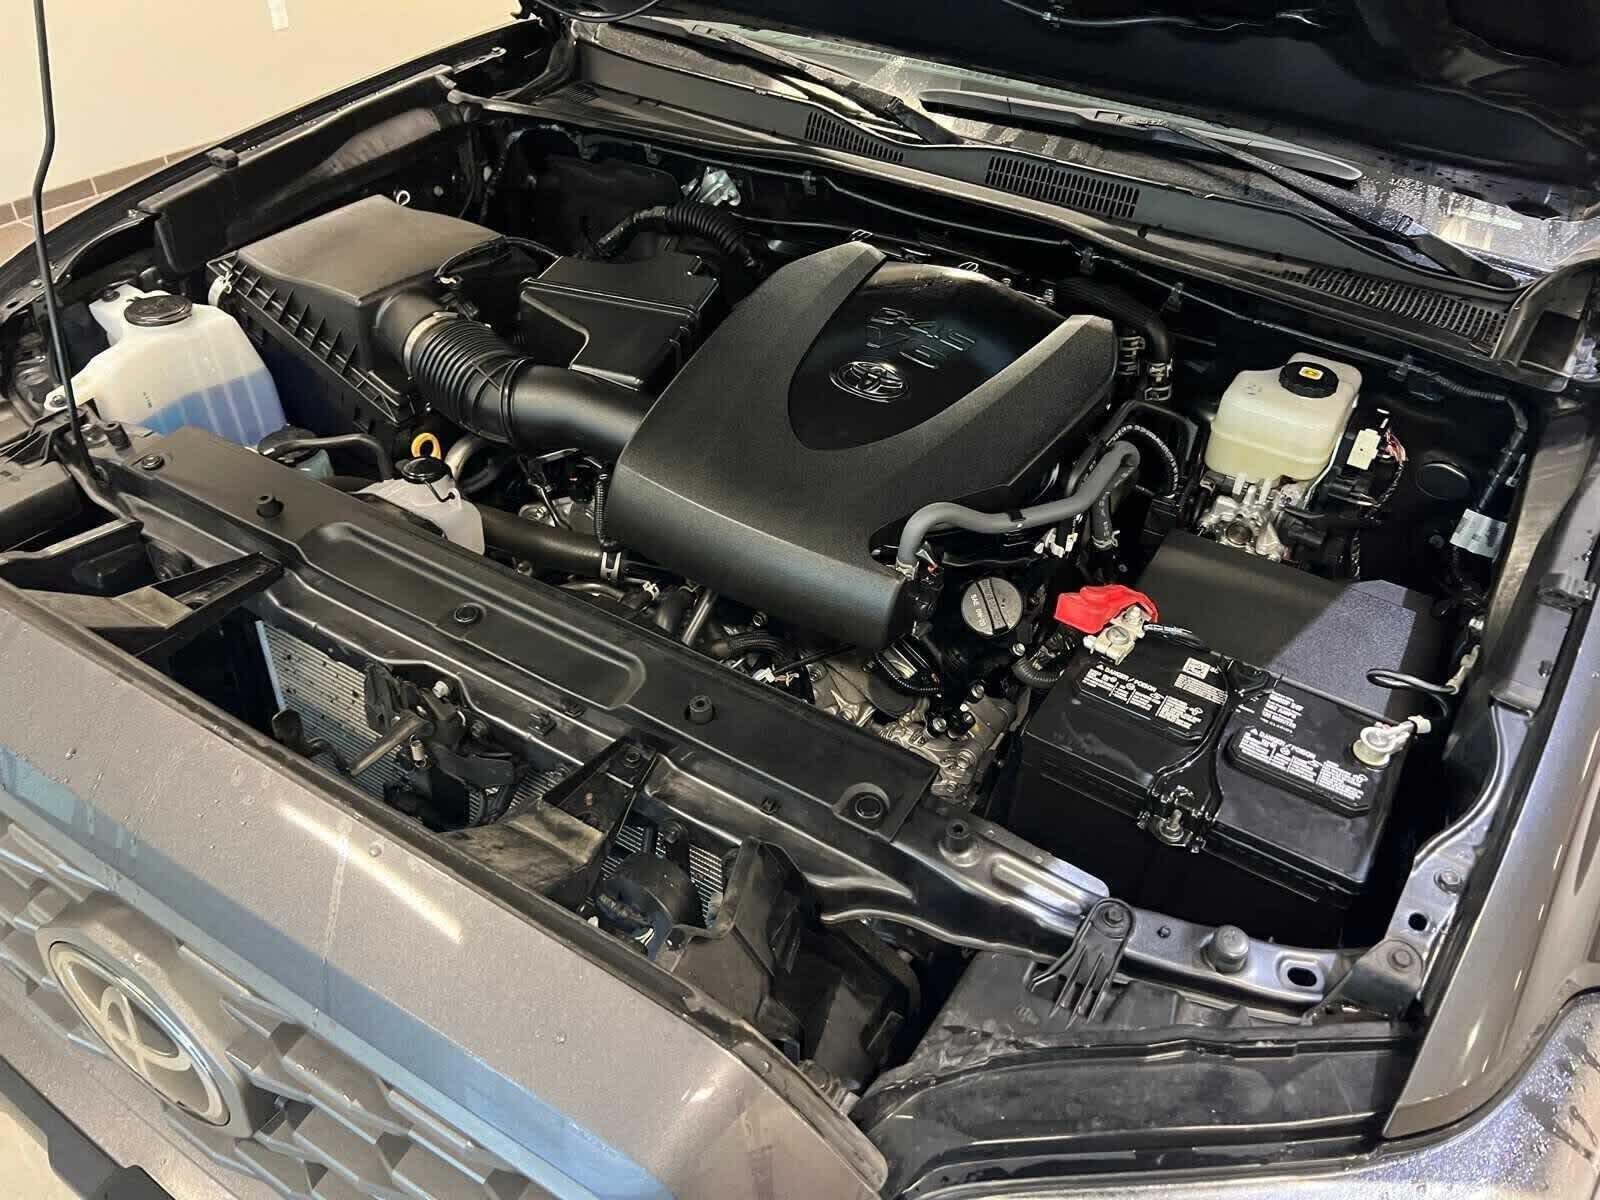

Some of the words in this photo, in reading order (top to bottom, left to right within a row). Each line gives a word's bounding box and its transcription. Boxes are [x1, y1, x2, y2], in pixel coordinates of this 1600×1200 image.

[1105, 667, 1129, 680] DANGER
[1134, 679, 1157, 692] POISON
[1259, 731, 1286, 746] DANGER
[1291, 746, 1317, 760] POISON
